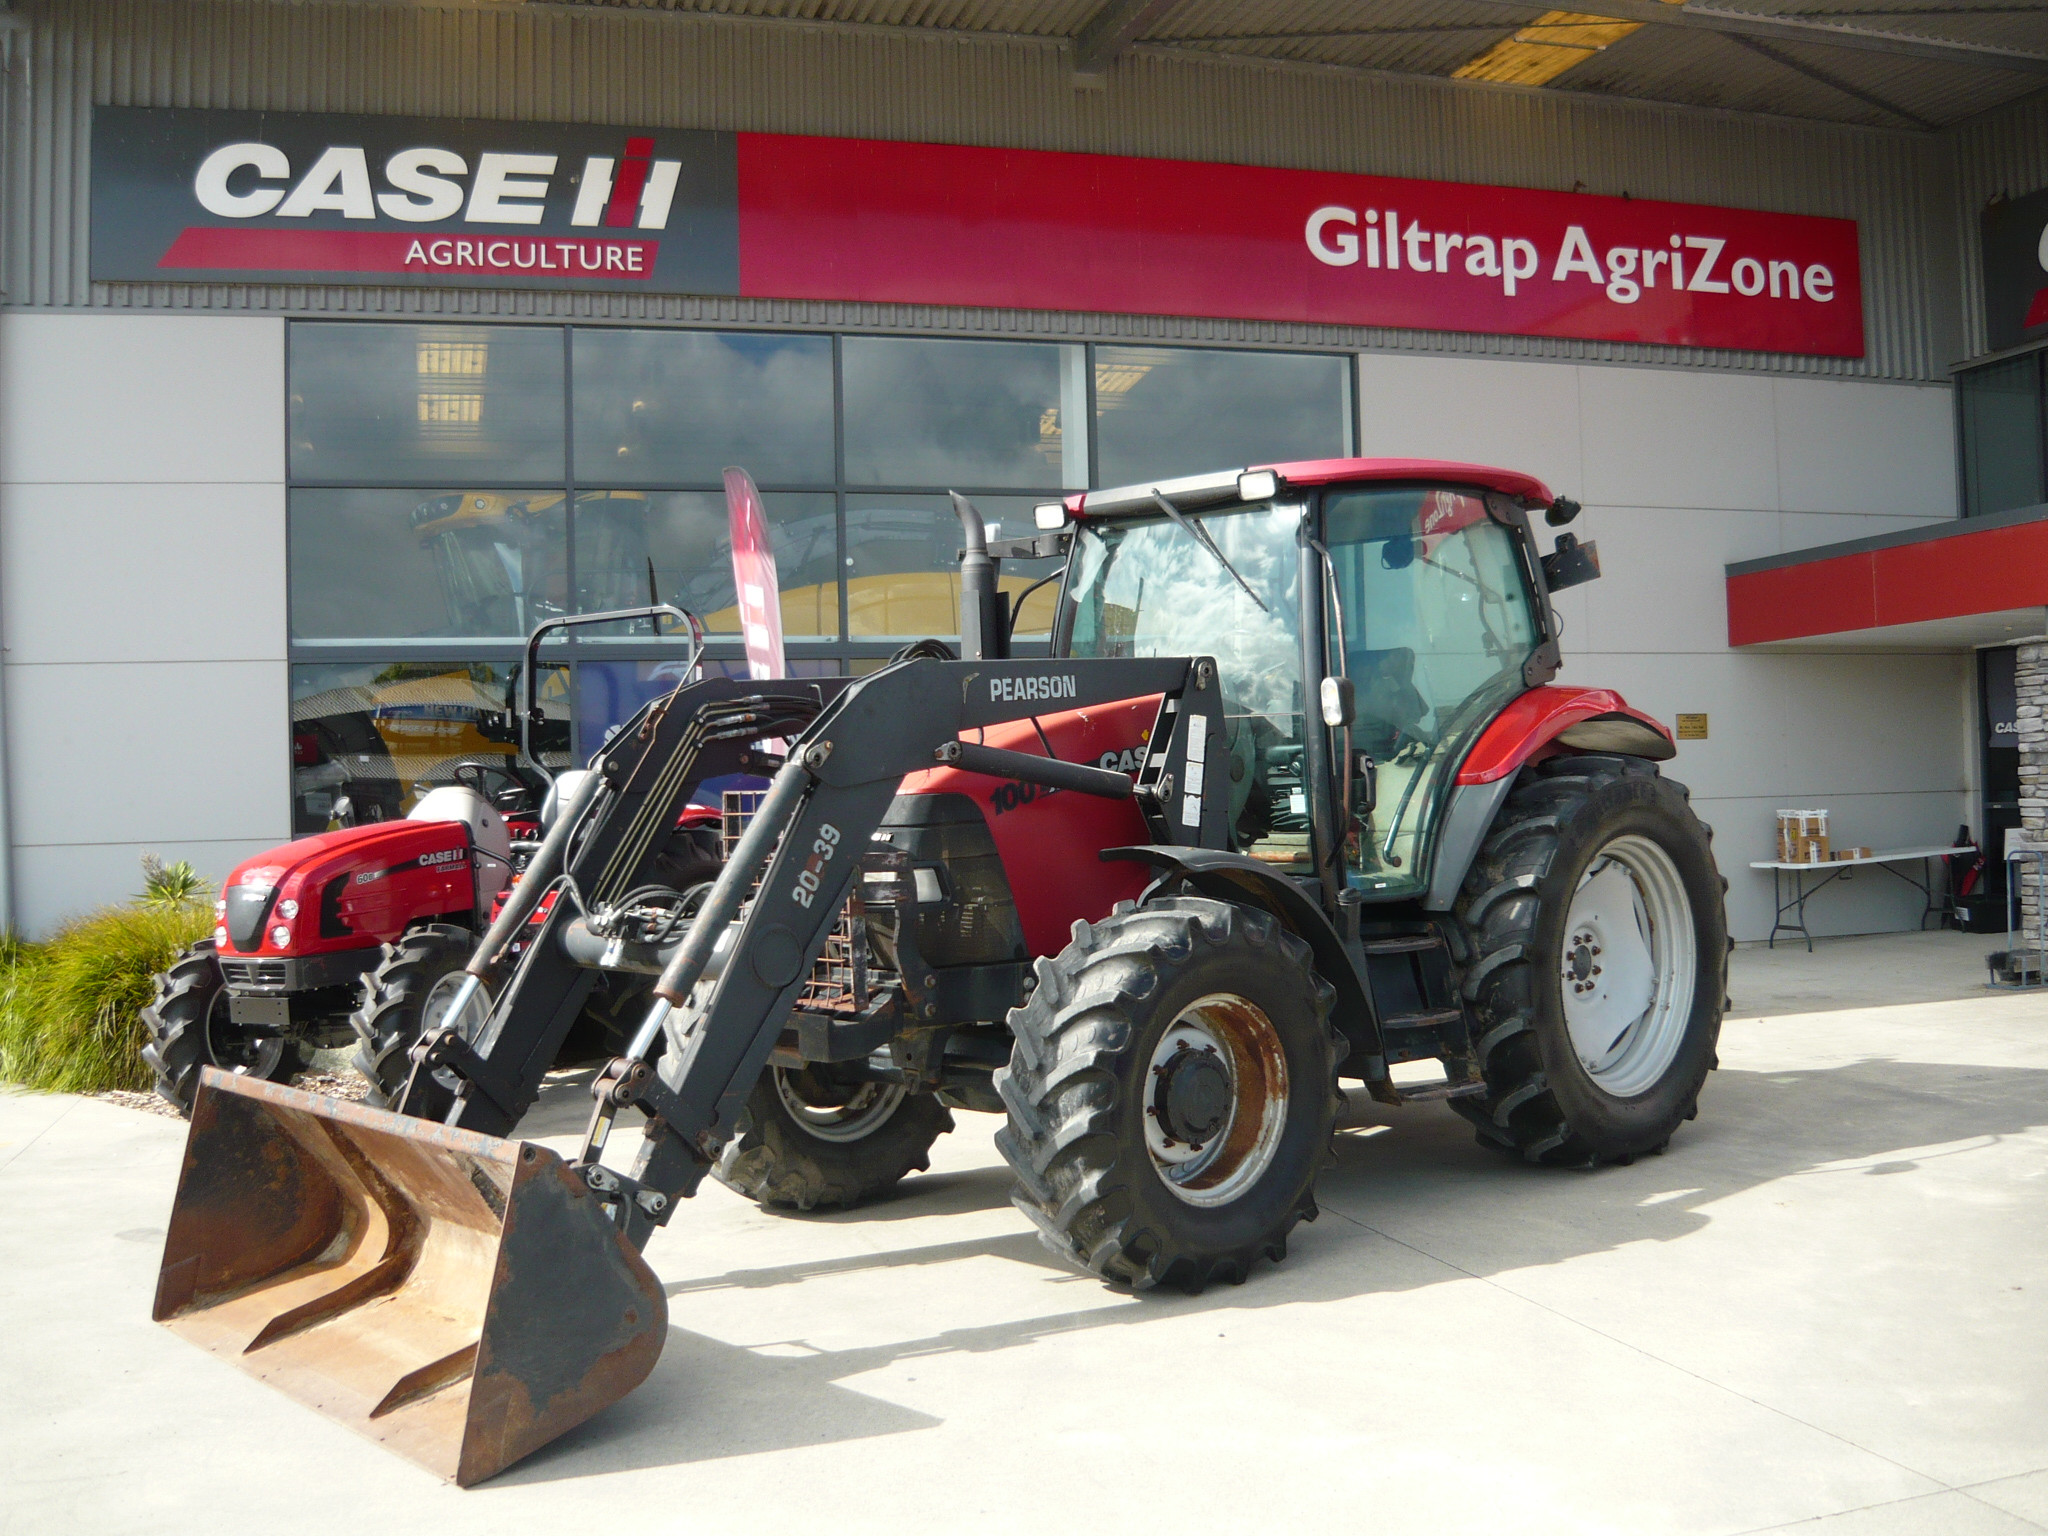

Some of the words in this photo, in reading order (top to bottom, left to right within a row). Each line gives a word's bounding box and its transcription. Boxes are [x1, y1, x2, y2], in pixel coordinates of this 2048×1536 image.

[193, 142, 559, 225] CASE
[403, 239, 645, 273] AGRICULTURE
[1304, 205, 1540, 298] Giltrap
[1552, 225, 1836, 305] AgriZone
[989, 674, 1077, 703] PEARSON
[1995, 721, 2019, 734] CAS
[1099, 745, 1148, 774] CAS
[989, 781, 1036, 817] 100
[418, 851, 452, 867] CASE
[791, 823, 841, 909] 20-39
